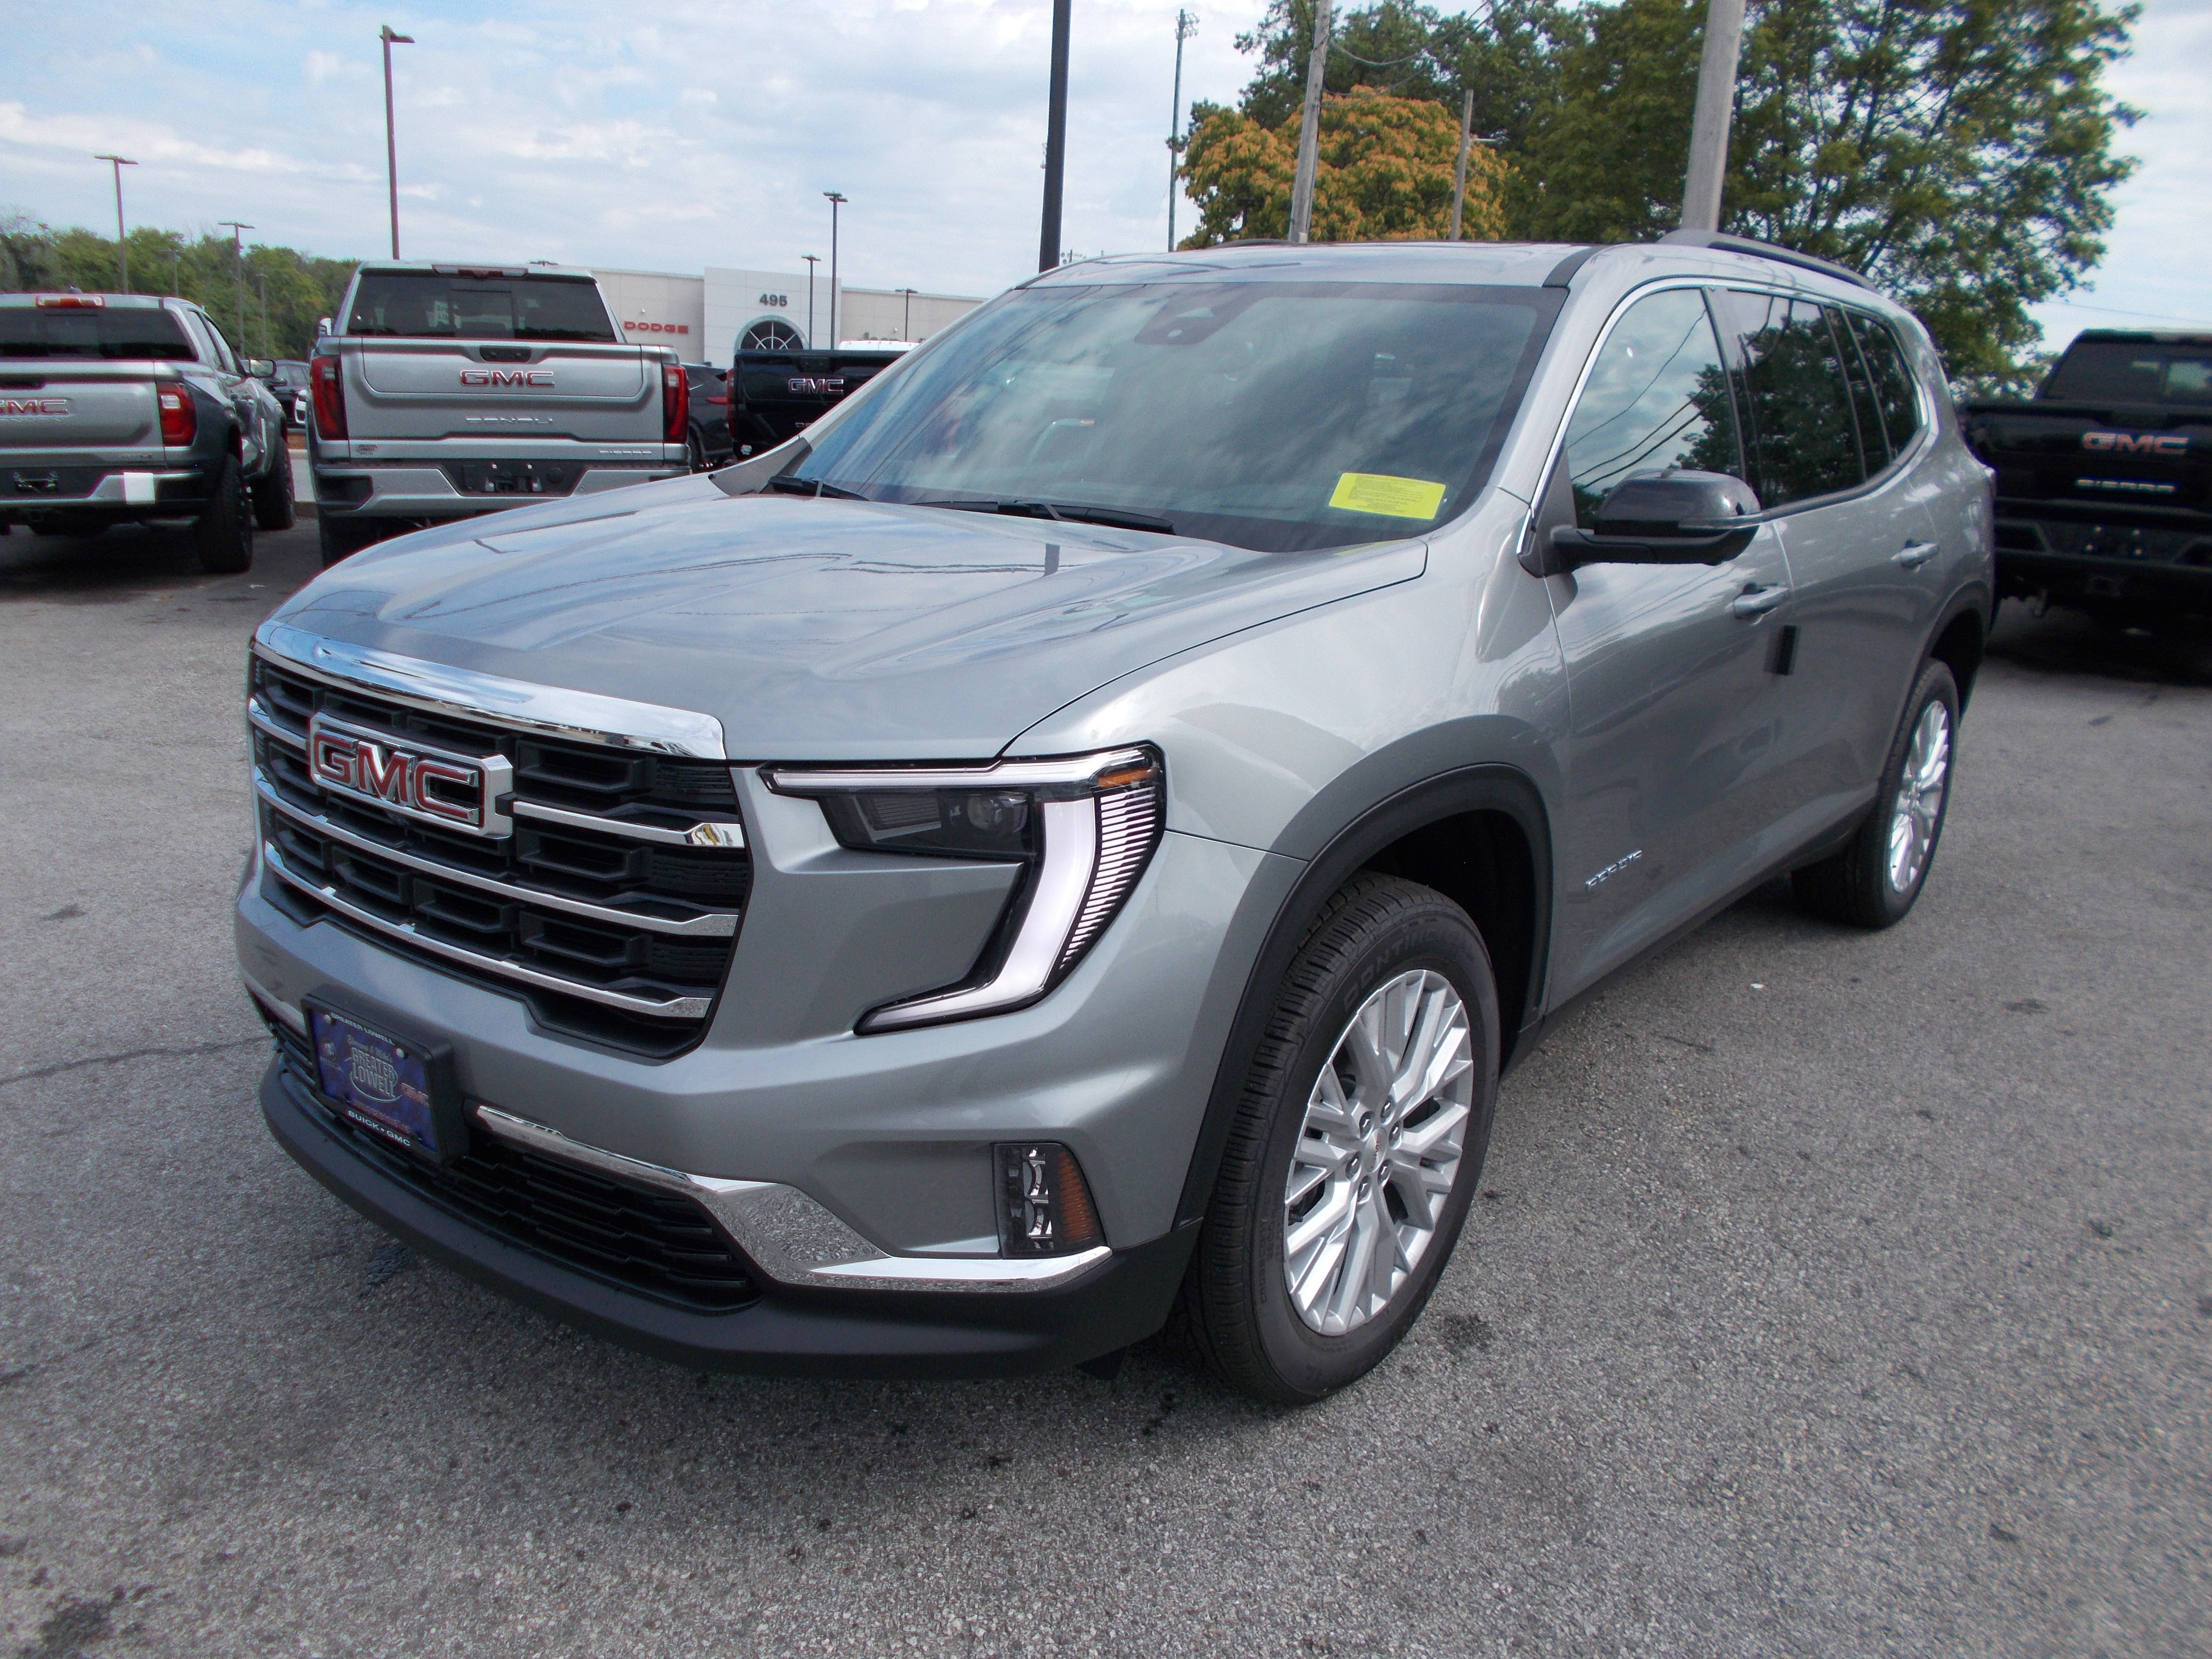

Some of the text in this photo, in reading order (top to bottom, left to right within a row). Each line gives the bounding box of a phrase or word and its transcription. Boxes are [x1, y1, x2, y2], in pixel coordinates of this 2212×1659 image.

[759, 294, 787, 307] 495
[624, 321, 689, 334] DODGE
[461, 370, 555, 388] GMC
[788, 378, 844, 395] GMC
[0, 400, 68, 415] MC
[2082, 432, 2189, 455] GMC
[313, 728, 480, 825] GMC
[351, 1047, 395, 1081] GREATER
[352, 1061, 396, 1098] LOWELL
[348, 1110, 379, 1130] BUICK
[386, 1130, 411, 1147] GMC
